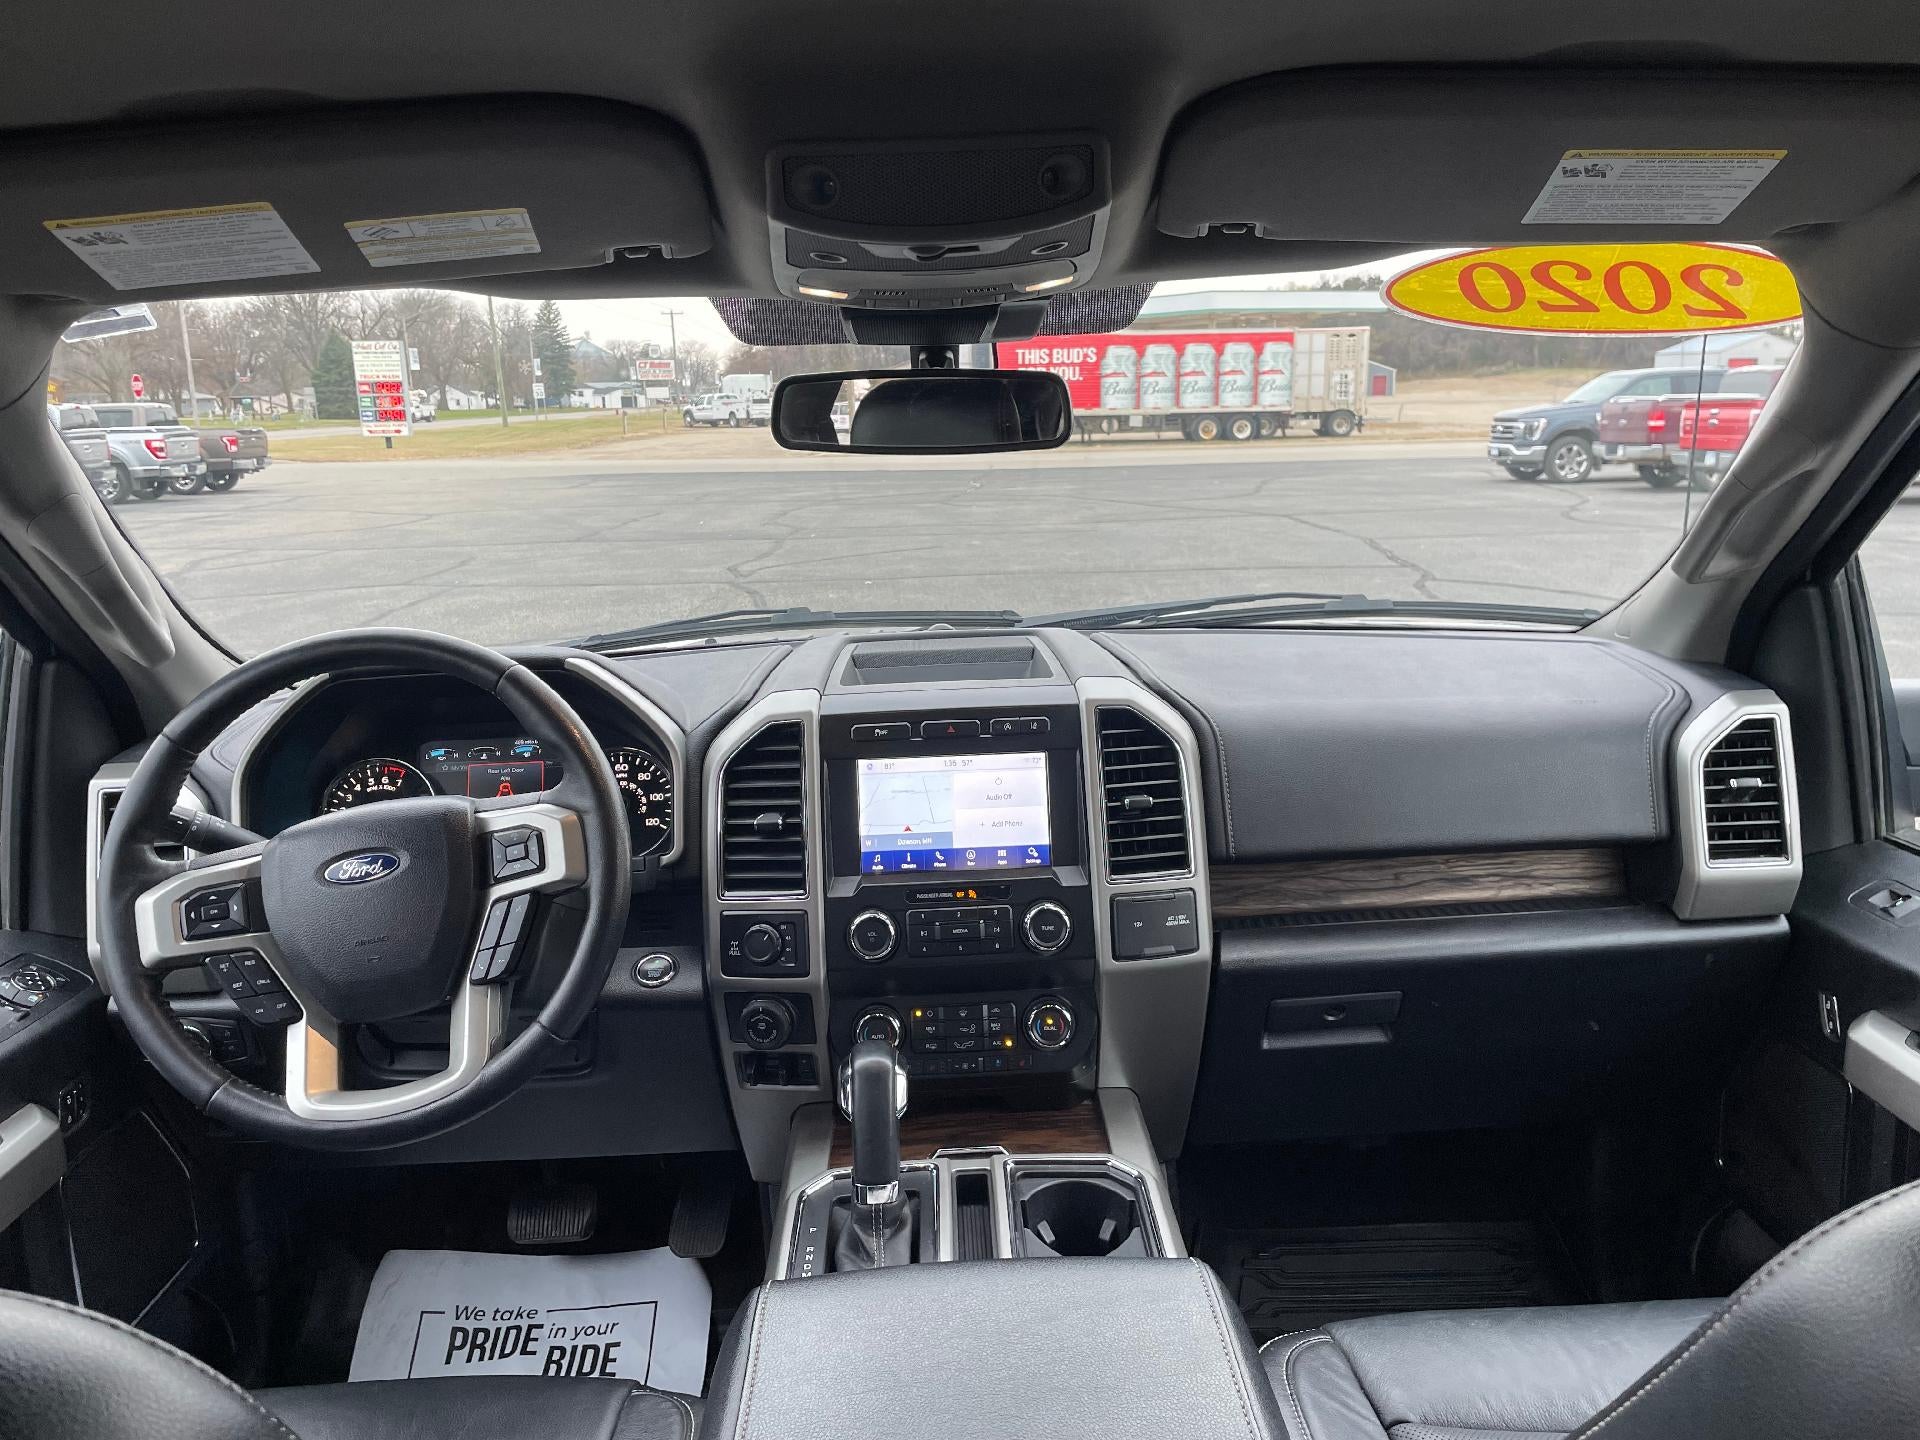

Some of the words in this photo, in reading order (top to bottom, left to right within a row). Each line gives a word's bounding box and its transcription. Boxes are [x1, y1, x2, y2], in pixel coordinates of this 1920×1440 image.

[1015, 348, 1050, 365] THIS
[1052, 347, 1098, 364] BUD'S
[614, 763, 629, 771] 60
[381, 776, 389, 784] 6
[637, 772, 651, 780] 80
[367, 778, 375, 786] 5
[395, 779, 402, 787] 7
[353, 783, 361, 792] 4
[344, 794, 353, 802] 3
[649, 793, 664, 801] 100
[645, 818, 660, 826] 120
[338, 857, 384, 880] Ford
[454, 1304, 485, 1322] We
[491, 1306, 539, 1322] take
[444, 1322, 545, 1366] PRIDE
[546, 1323, 567, 1340] in
[568, 1320, 620, 1341] your
[541, 1341, 622, 1378] RIDE
